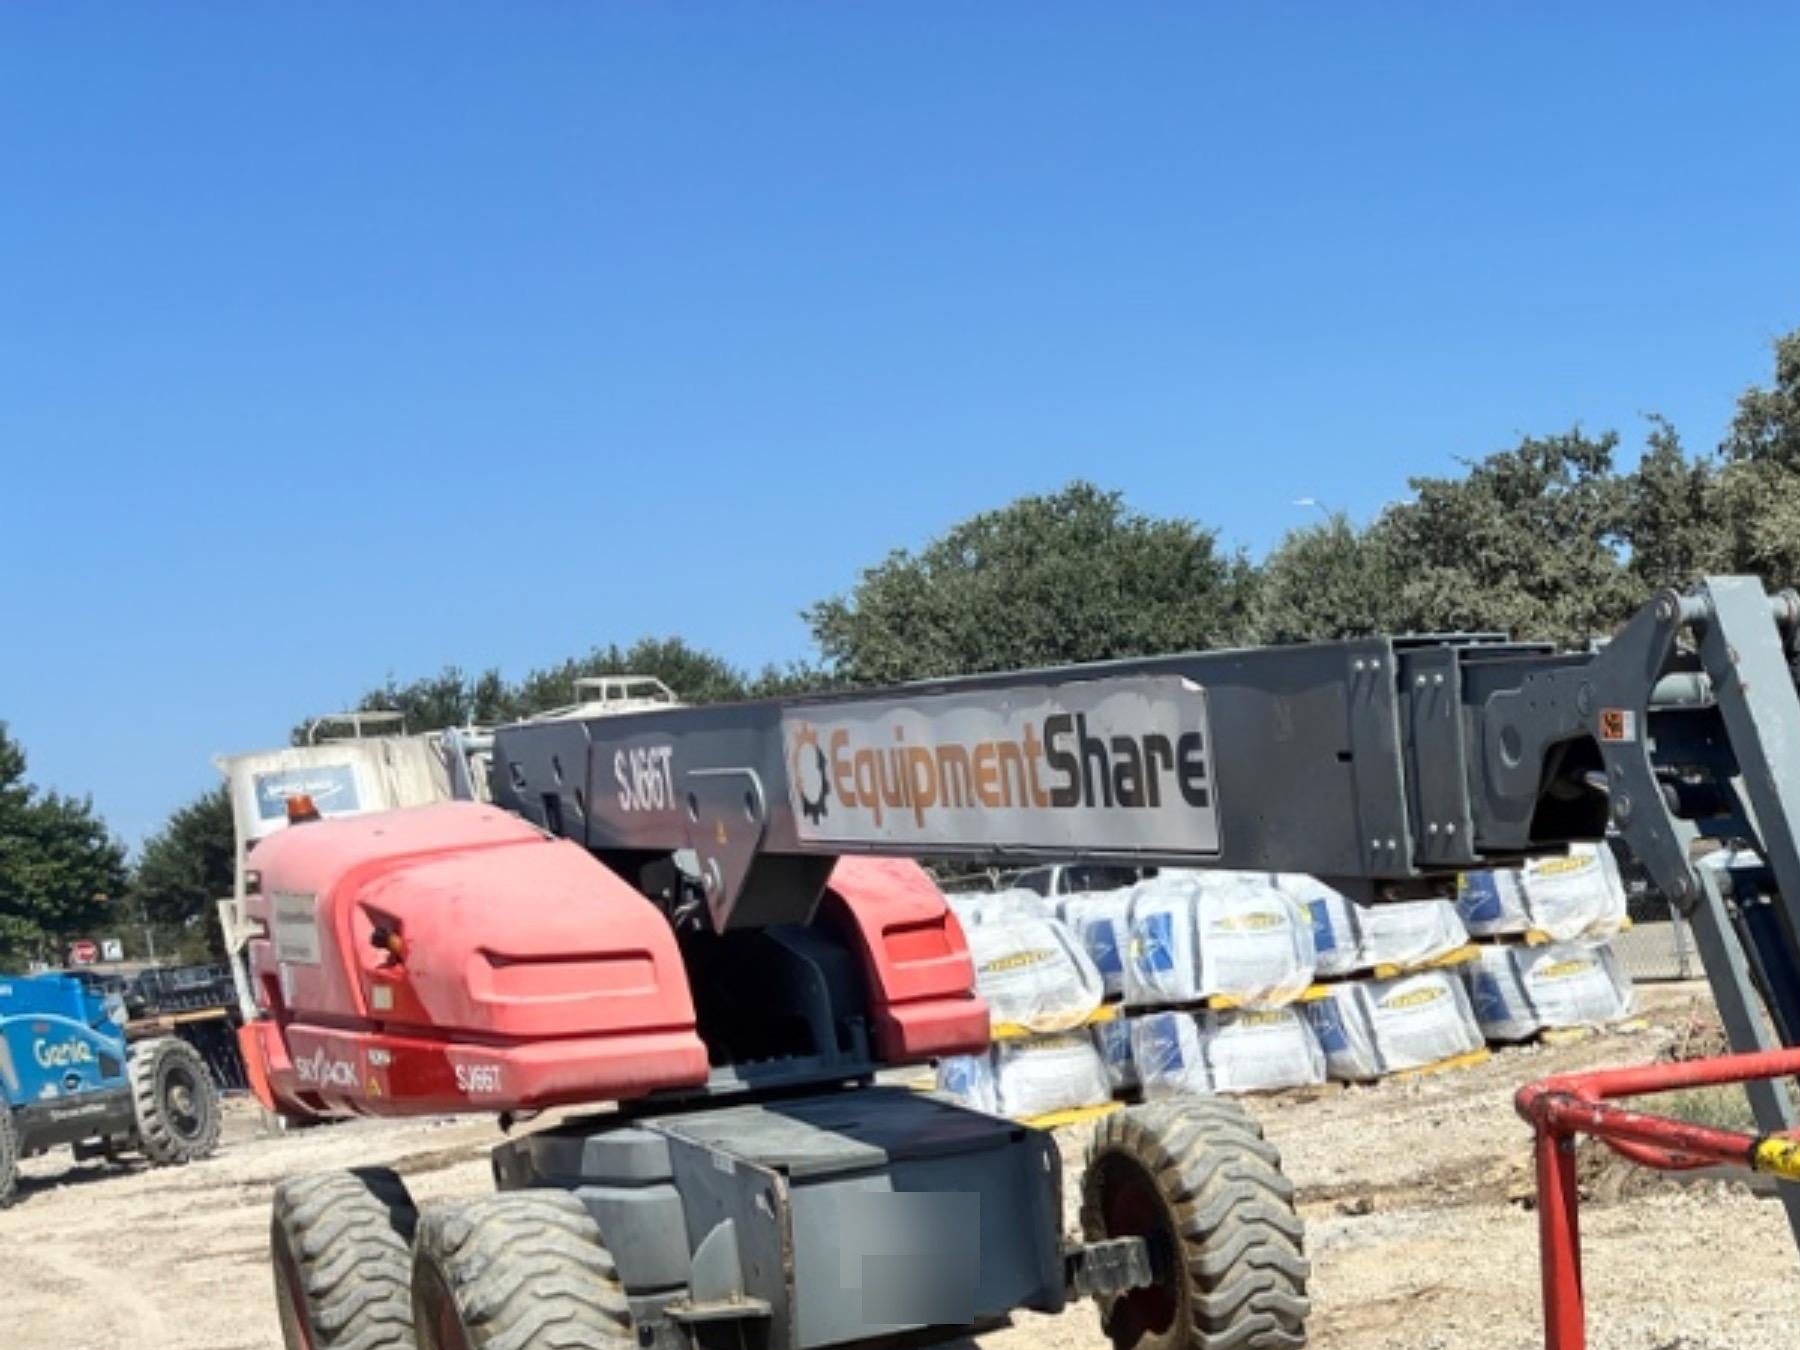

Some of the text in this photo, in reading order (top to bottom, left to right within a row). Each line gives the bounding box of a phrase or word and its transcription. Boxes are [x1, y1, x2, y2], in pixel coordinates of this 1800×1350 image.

[613, 745, 677, 812] SJ66T
[829, 712, 1209, 829] EquipmentShare
[33, 1036, 95, 1069] Genie
[294, 1046, 360, 1088] SKYJACK
[455, 1063, 502, 1093] SJ66T
